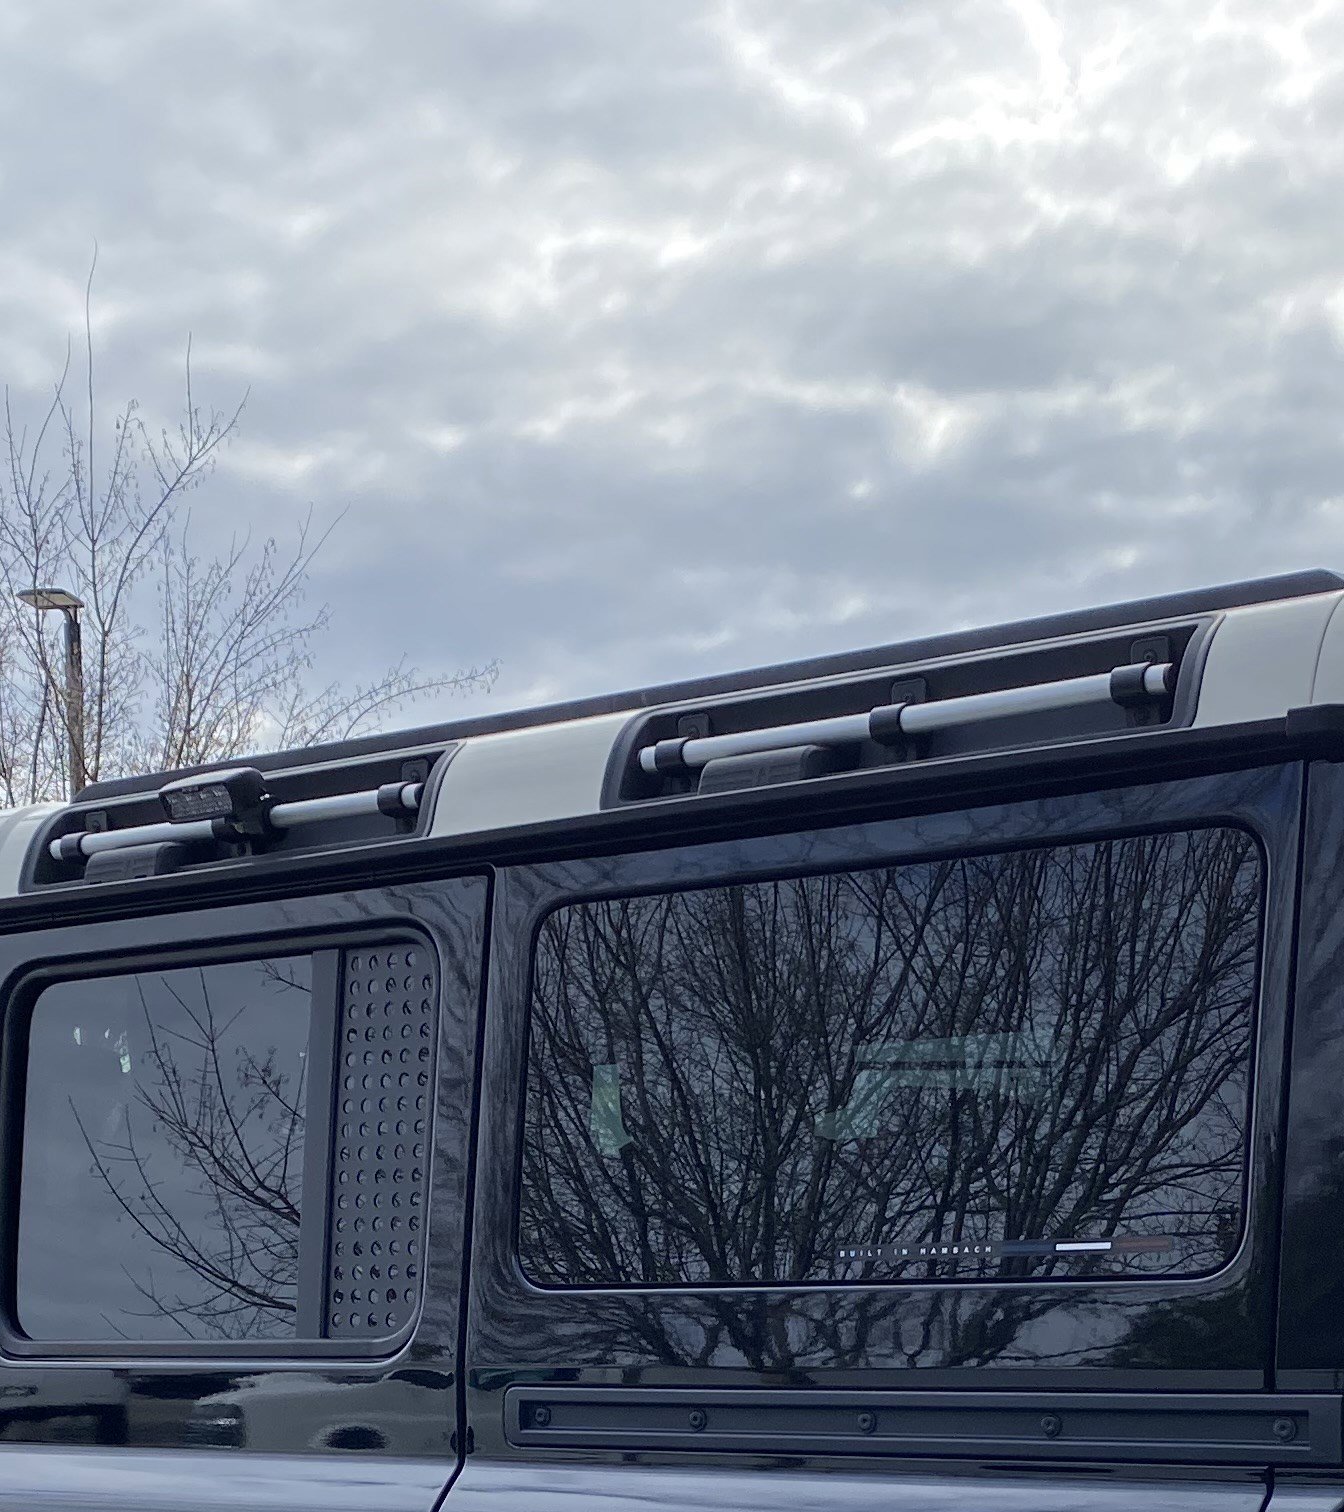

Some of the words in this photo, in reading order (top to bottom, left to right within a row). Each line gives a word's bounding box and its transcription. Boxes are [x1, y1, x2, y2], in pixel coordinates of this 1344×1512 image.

[839, 1249, 882, 1258] BUILT
[894, 1248, 908, 1256] IN
[920, 1246, 991, 1255] HAMBACH
